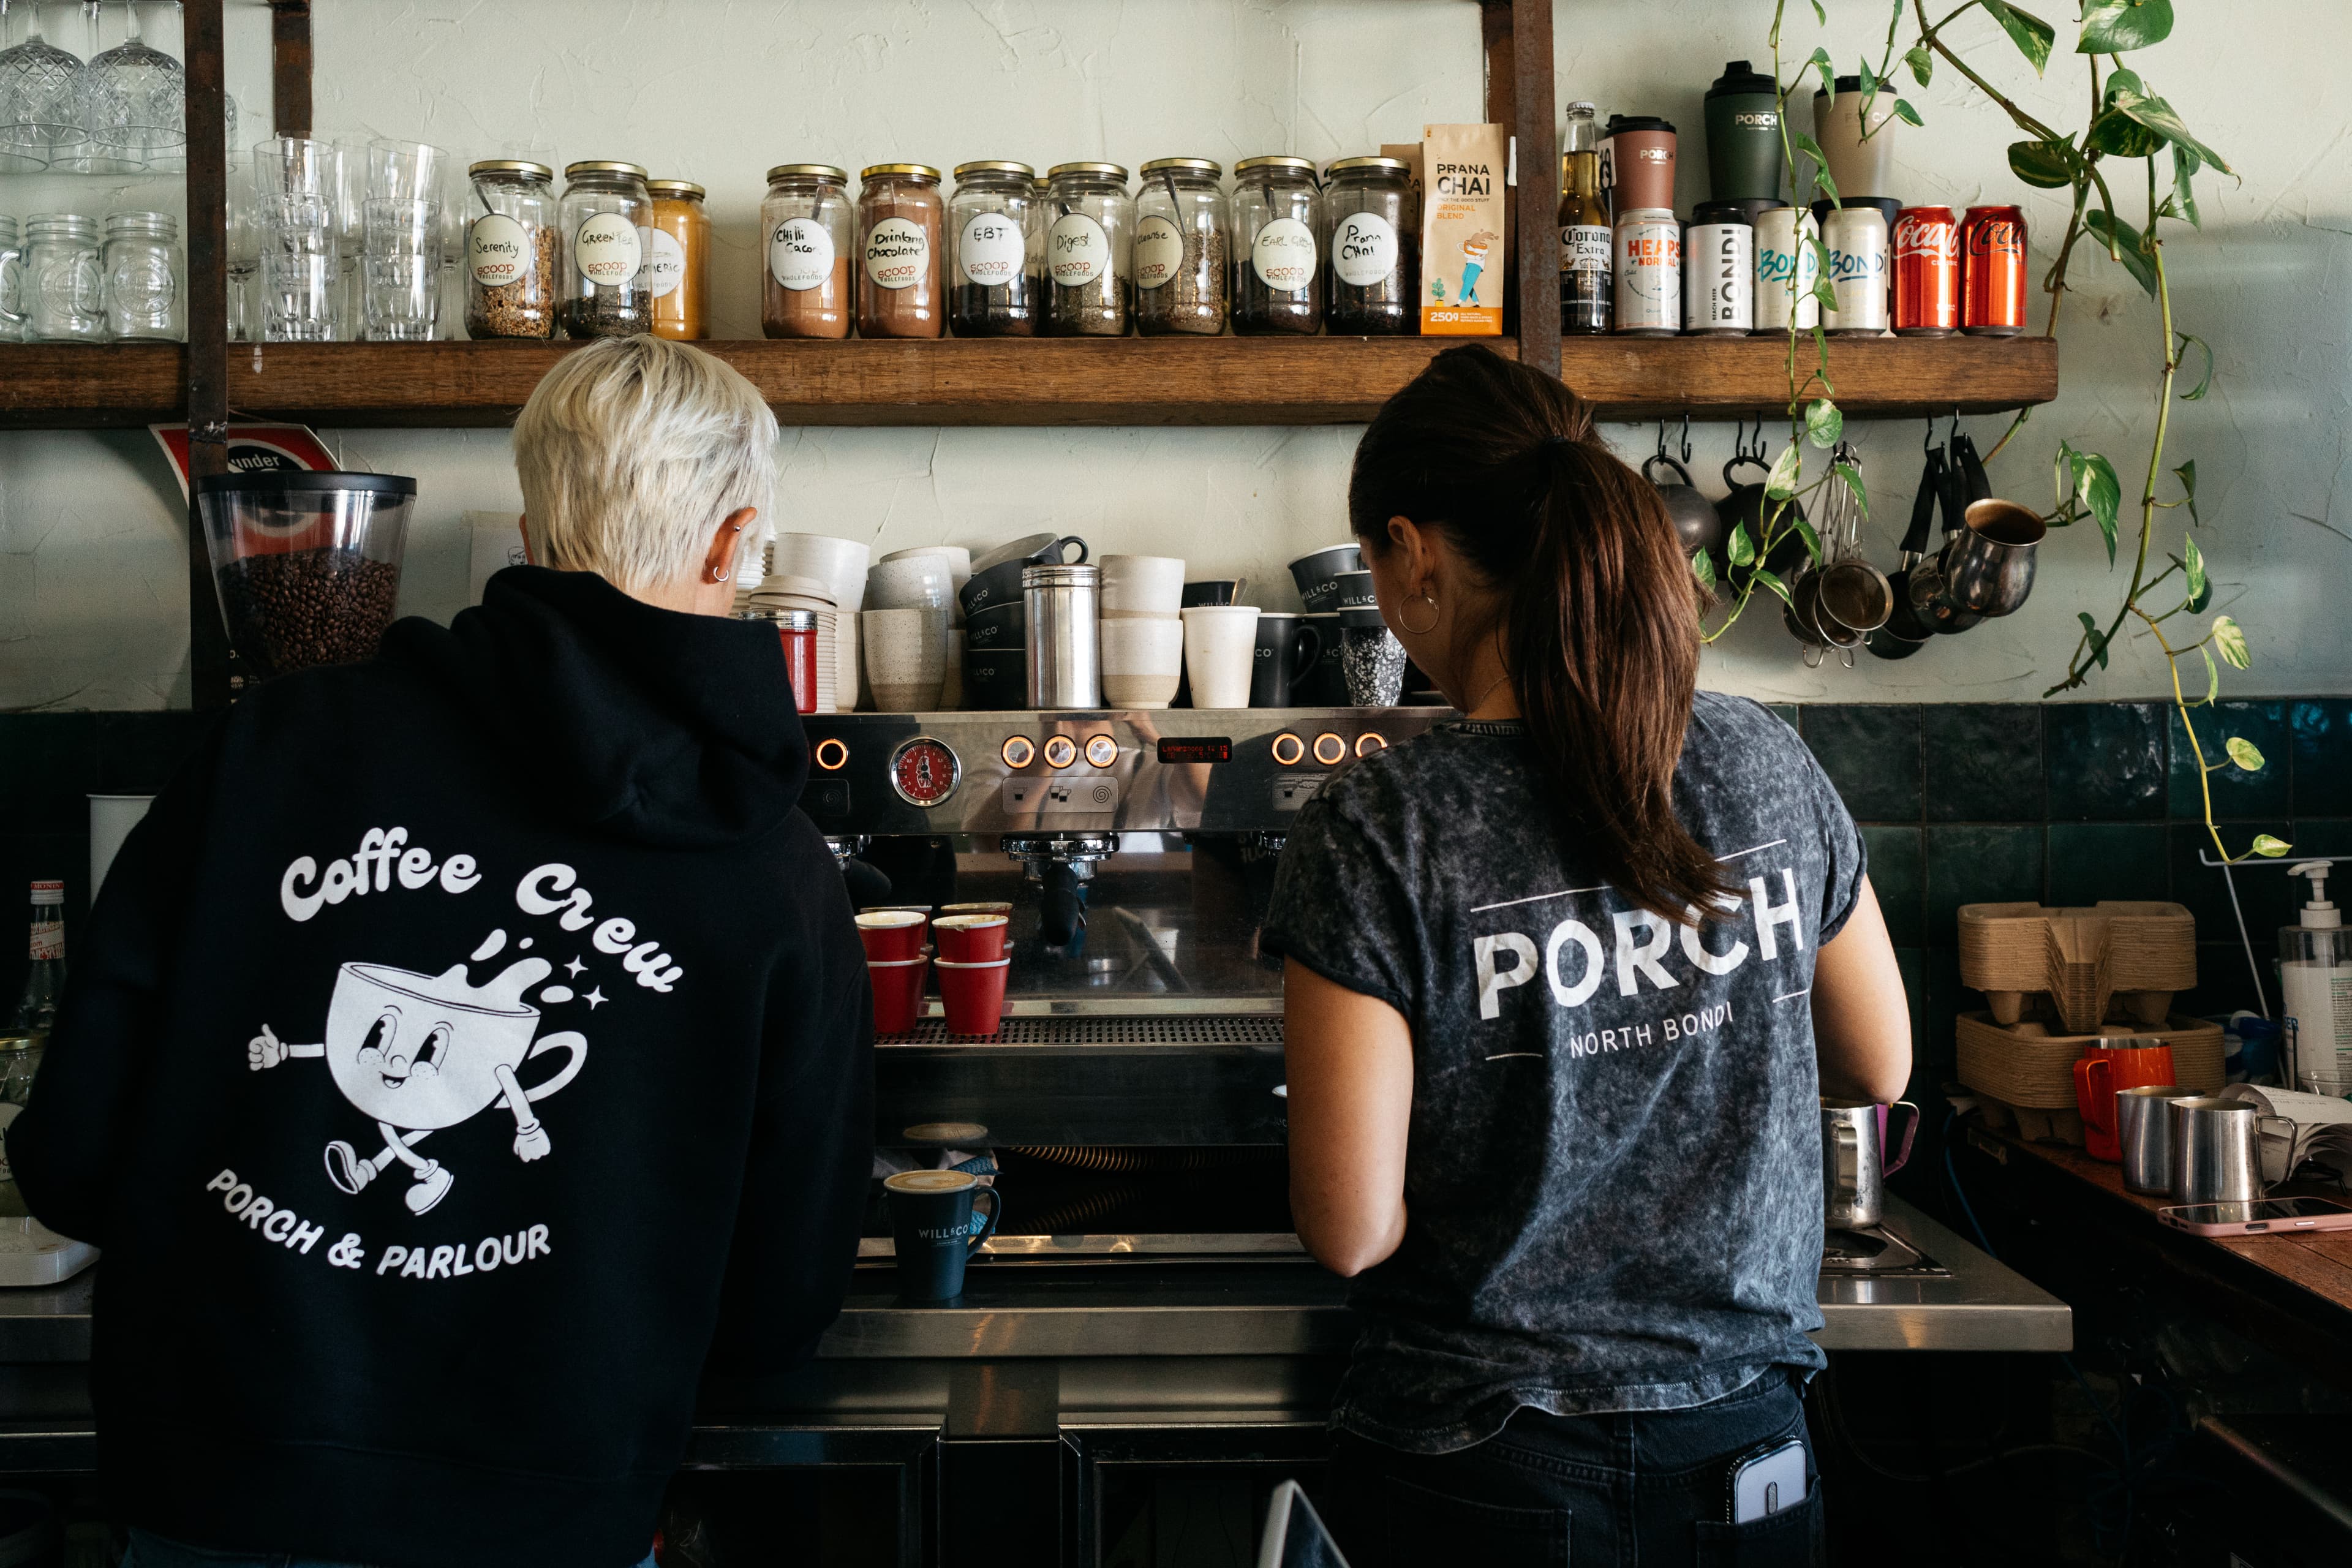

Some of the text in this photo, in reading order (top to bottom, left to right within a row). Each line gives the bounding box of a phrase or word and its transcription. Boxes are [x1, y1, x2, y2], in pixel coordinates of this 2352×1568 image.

[1735, 114, 1777, 126] PORCH
[1437, 164, 1490, 175] PRANA
[1438, 176, 1490, 195] CHAI
[1057, 233, 1091, 252] Digest
[1561, 227, 1610, 247] Corona
[475, 237, 519, 258] Serenity
[1577, 243, 1605, 255] Extra
[1628, 239, 1680, 258] HEAPS
[1638, 257, 1676, 267] NORAL
[1721, 229, 1741, 320] BONDI
[1430, 312, 1459, 322] 250g
[281, 827, 683, 992] Coffee Crew
[1473, 868, 1804, 1020] PORCH
[1570, 1001, 1733, 1058] NORTH BONDI
[206, 1169, 551, 1279] PORCH & PARLOUR
